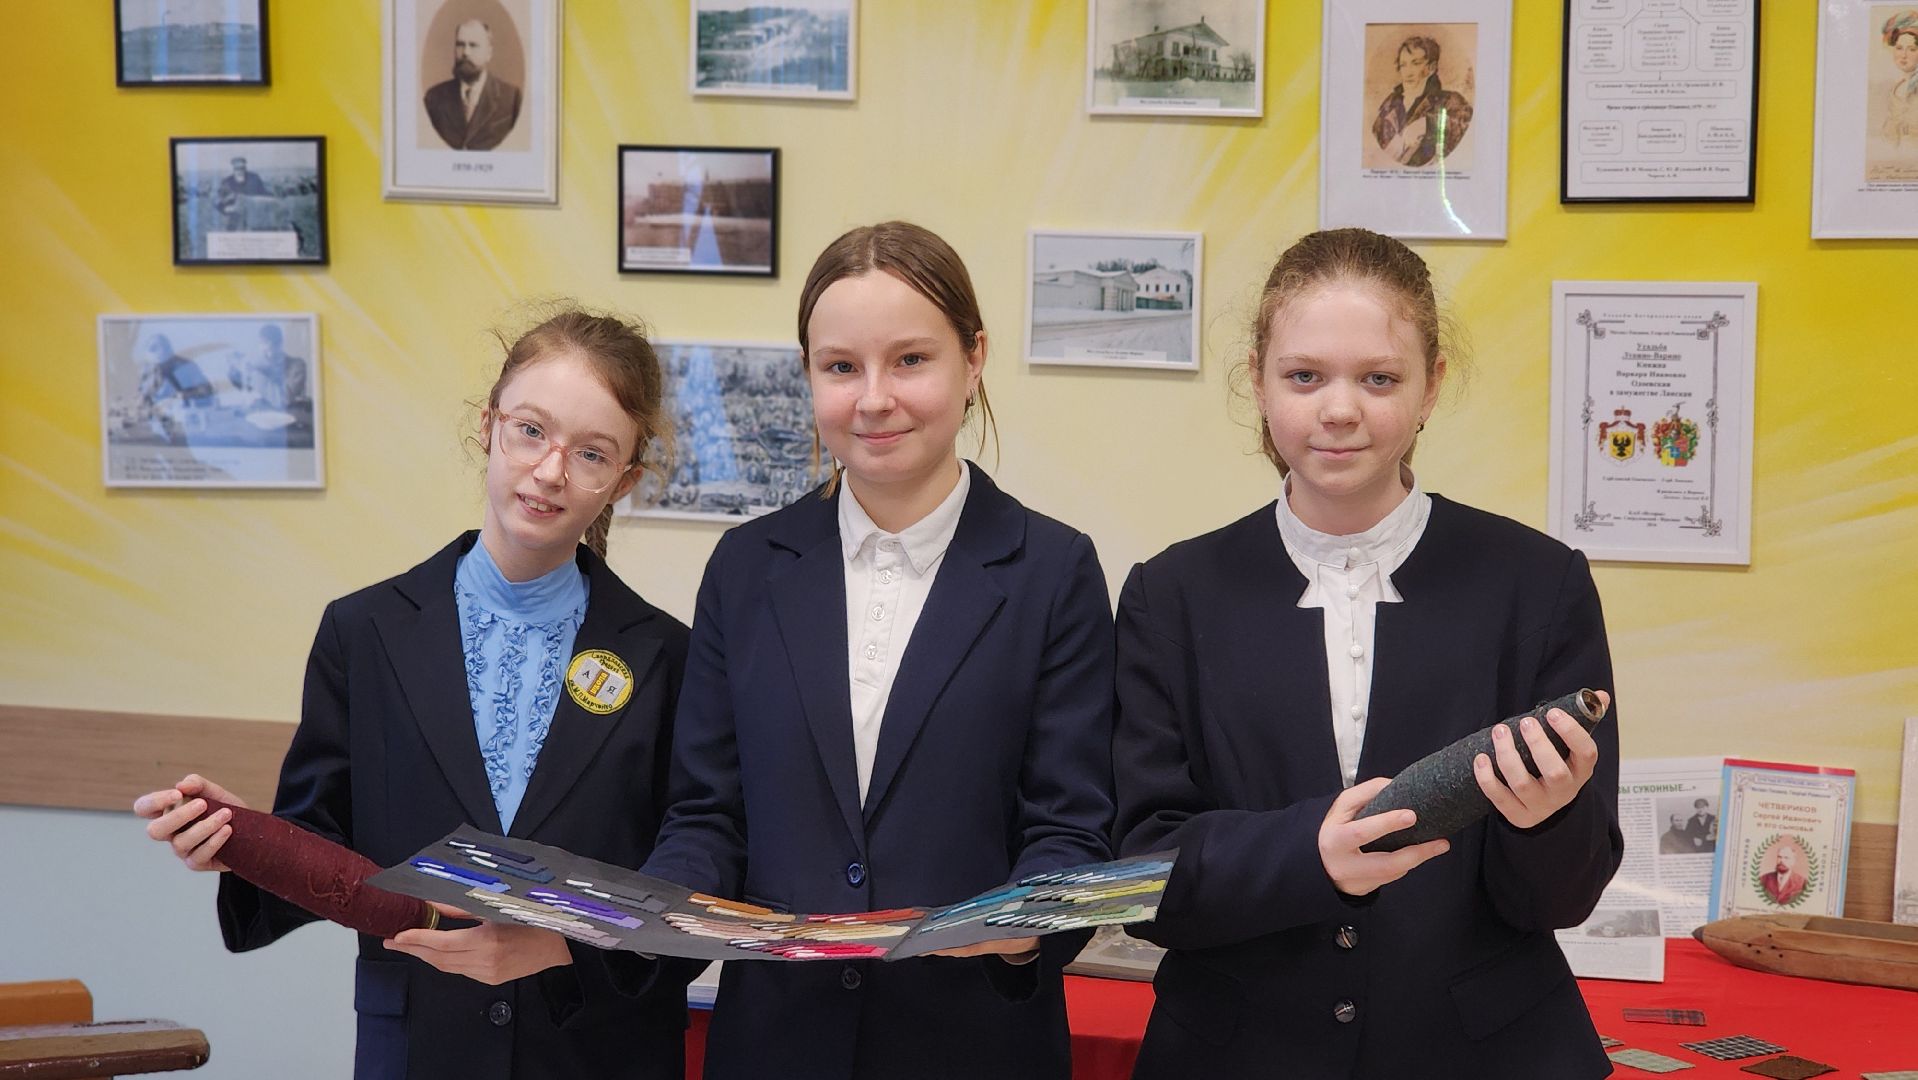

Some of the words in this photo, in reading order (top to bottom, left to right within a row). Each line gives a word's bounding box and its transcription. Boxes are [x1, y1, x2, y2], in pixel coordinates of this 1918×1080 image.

[1636, 343, 1667, 352] Усадьба
[1637, 361, 1667, 369] Княжна
[1616, 370, 1648, 379] Варвара
[1649, 371, 1687, 379] Ивановна
[1616, 390, 1659, 399] замужестве
[1660, 390, 1693, 398] Ланская
[582, 670, 591, 679] А
[607, 685, 617, 695] Я
[1758, 801, 1817, 814] ЧЕТВЕРИКОВ
[1753, 811, 1781, 822] Сергей
[1782, 814, 1822, 825] Иванович
[1778, 825, 1814, 833] сыновья
